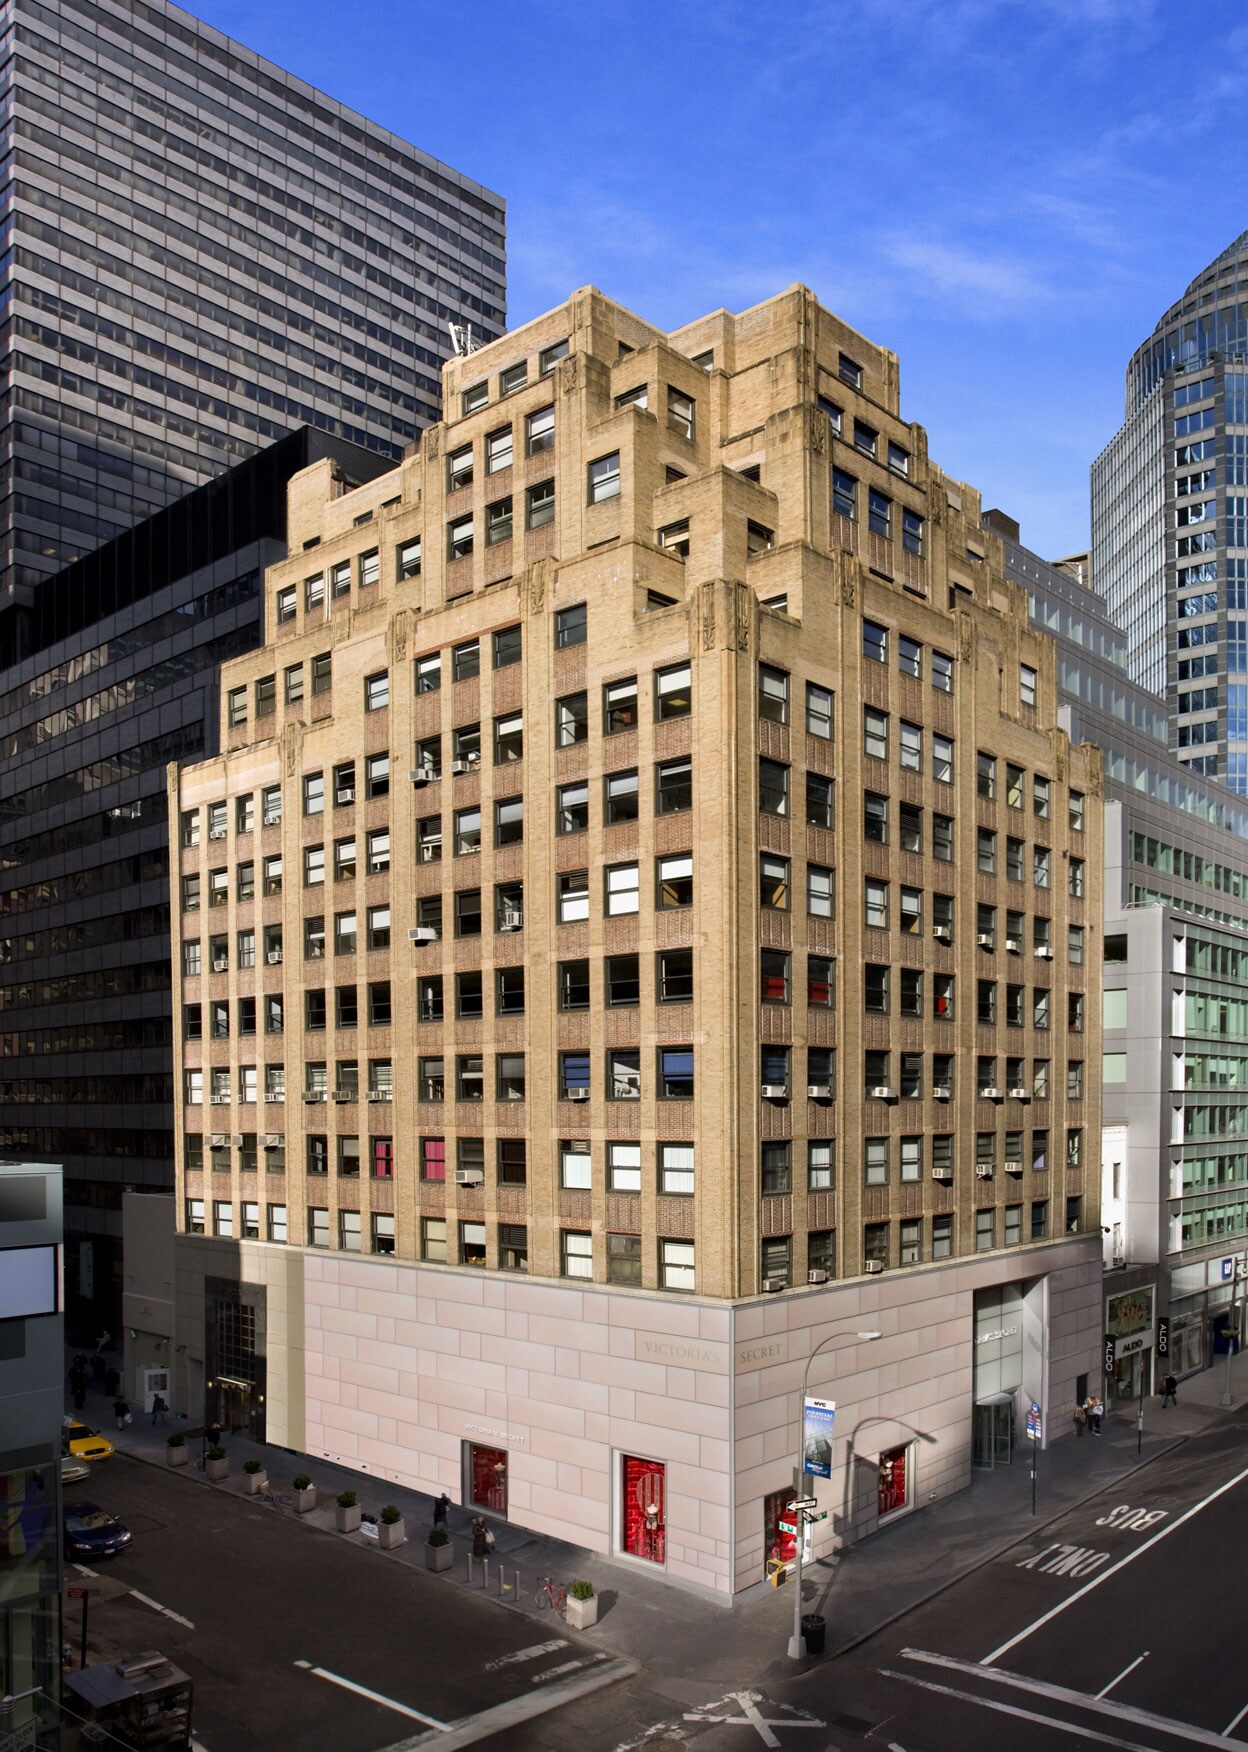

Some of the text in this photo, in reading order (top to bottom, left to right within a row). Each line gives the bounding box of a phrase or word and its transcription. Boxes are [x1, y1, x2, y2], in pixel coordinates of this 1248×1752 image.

[1123, 1339, 1143, 1352] ALDO
[1159, 1323, 1167, 1352] ALDO
[643, 1340, 782, 1363] VICTORIA'S SECRET
[1105, 1341, 1113, 1371] ALDO
[1095, 1505, 1169, 1531] BUS
[1015, 1543, 1110, 1577] ONLY
